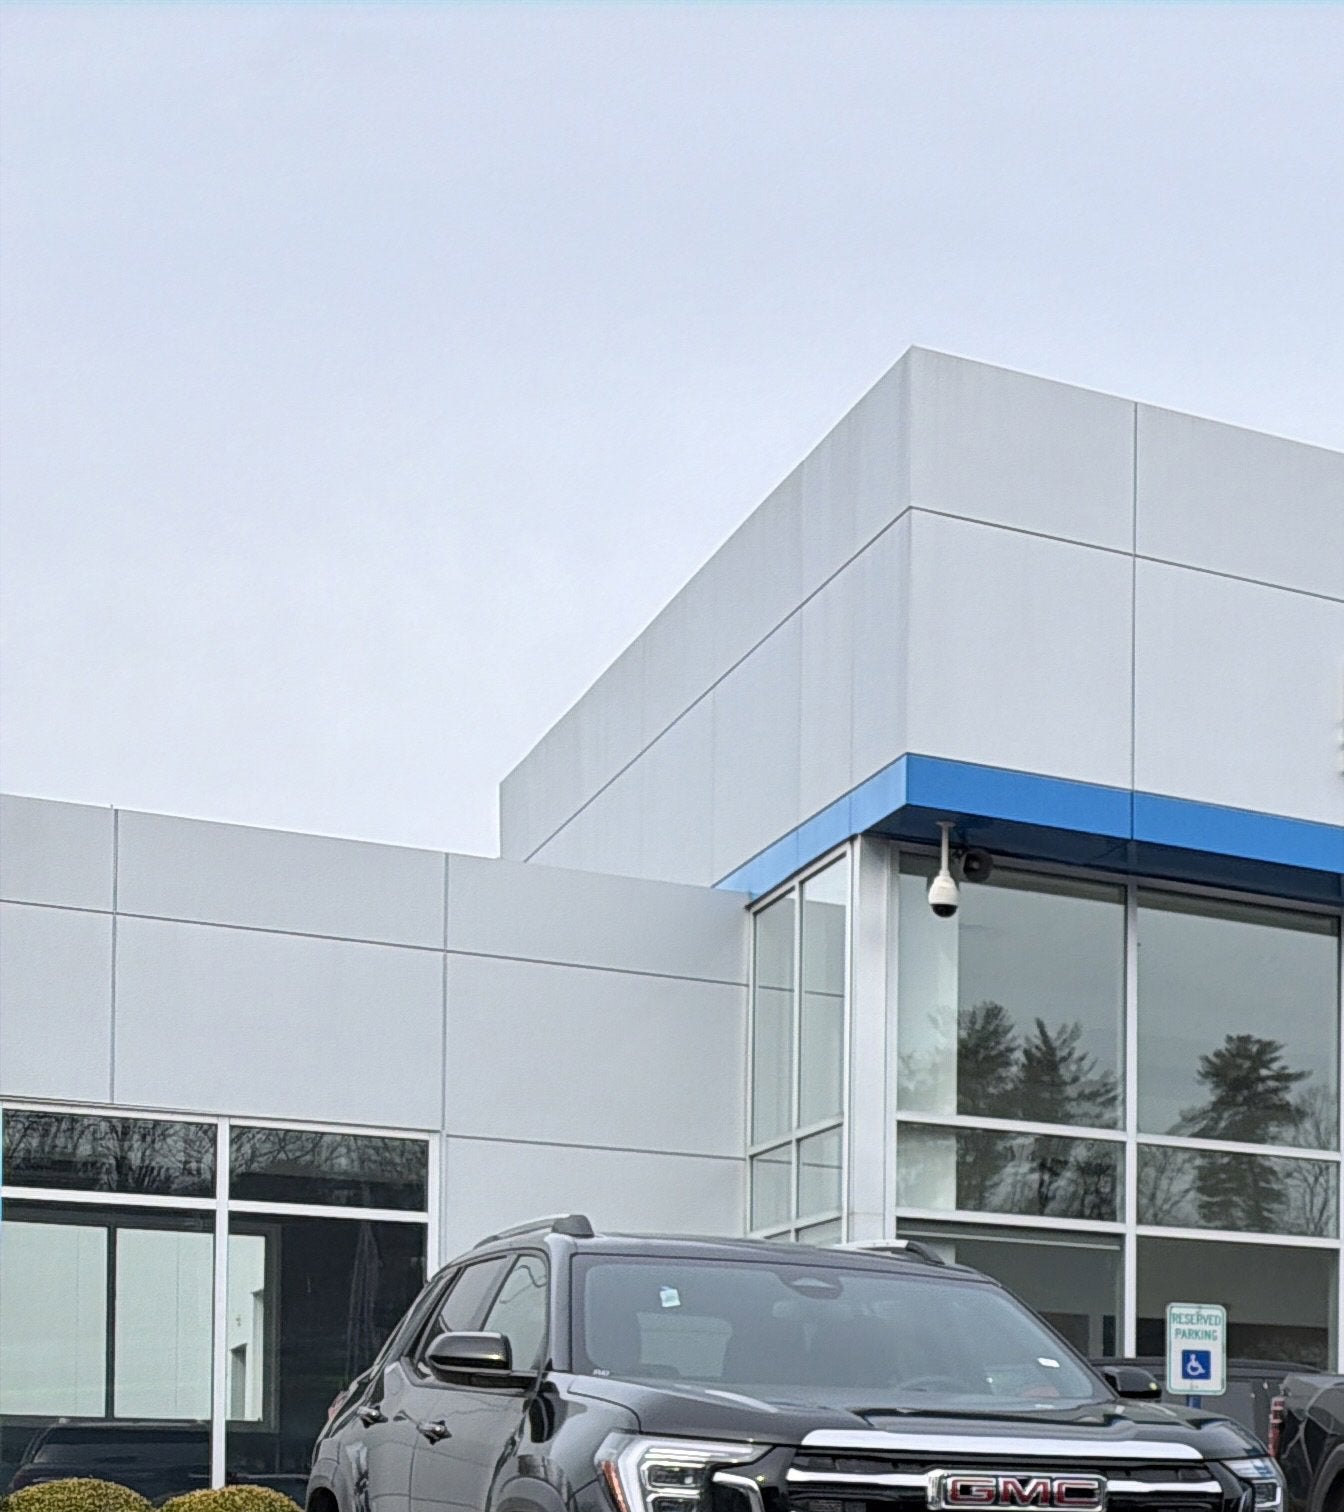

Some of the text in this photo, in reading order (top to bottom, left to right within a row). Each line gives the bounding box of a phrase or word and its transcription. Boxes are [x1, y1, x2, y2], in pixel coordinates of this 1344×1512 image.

[1171, 1312, 1221, 1326] RESERVED
[1174, 1328, 1218, 1341] PARKING
[947, 1476, 1100, 1506] GMC
